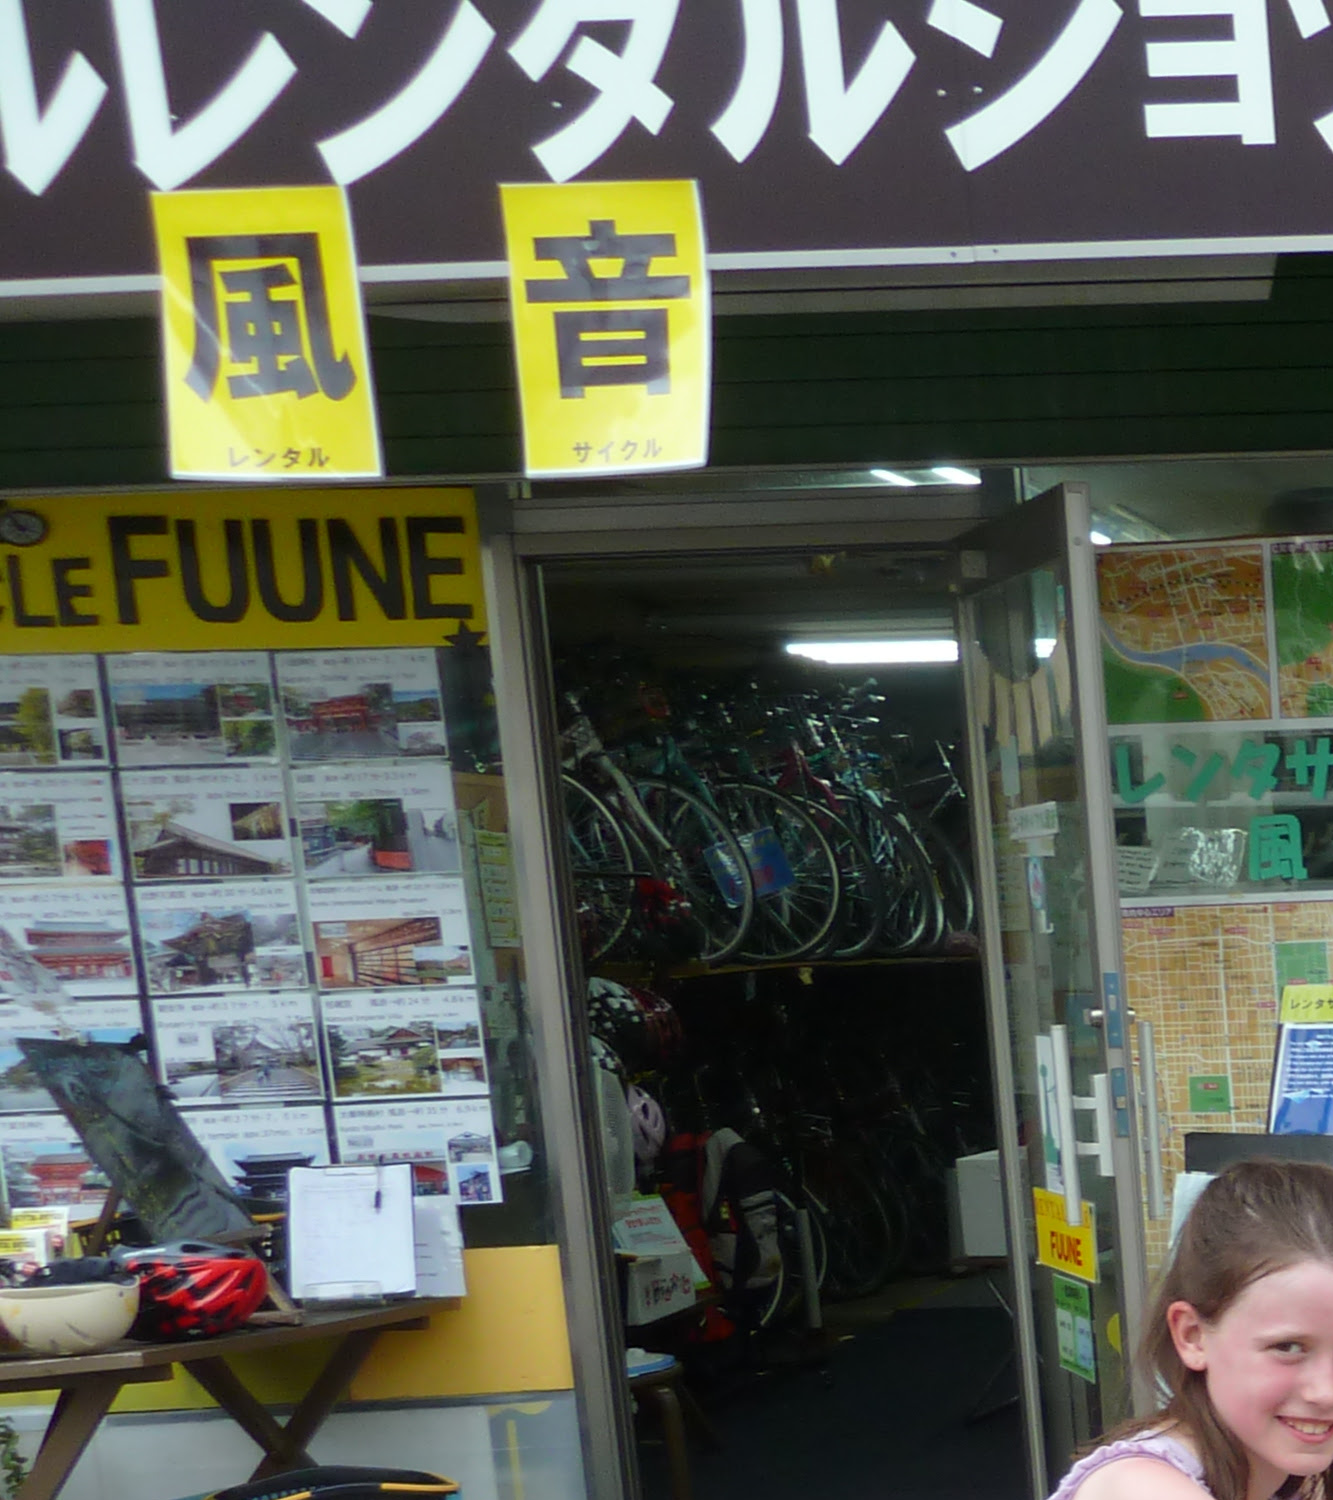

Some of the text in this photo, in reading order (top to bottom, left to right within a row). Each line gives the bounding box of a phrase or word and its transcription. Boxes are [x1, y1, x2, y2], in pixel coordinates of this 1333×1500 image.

[183, 231, 357, 403] 風
[525, 219, 692, 400] 音
[226, 445, 331, 470] レンタル
[571, 438, 664, 464] サイクル
[0, 514, 474, 628] LE FUUNE
[1050, 1230, 1083, 1267] FUUNE
